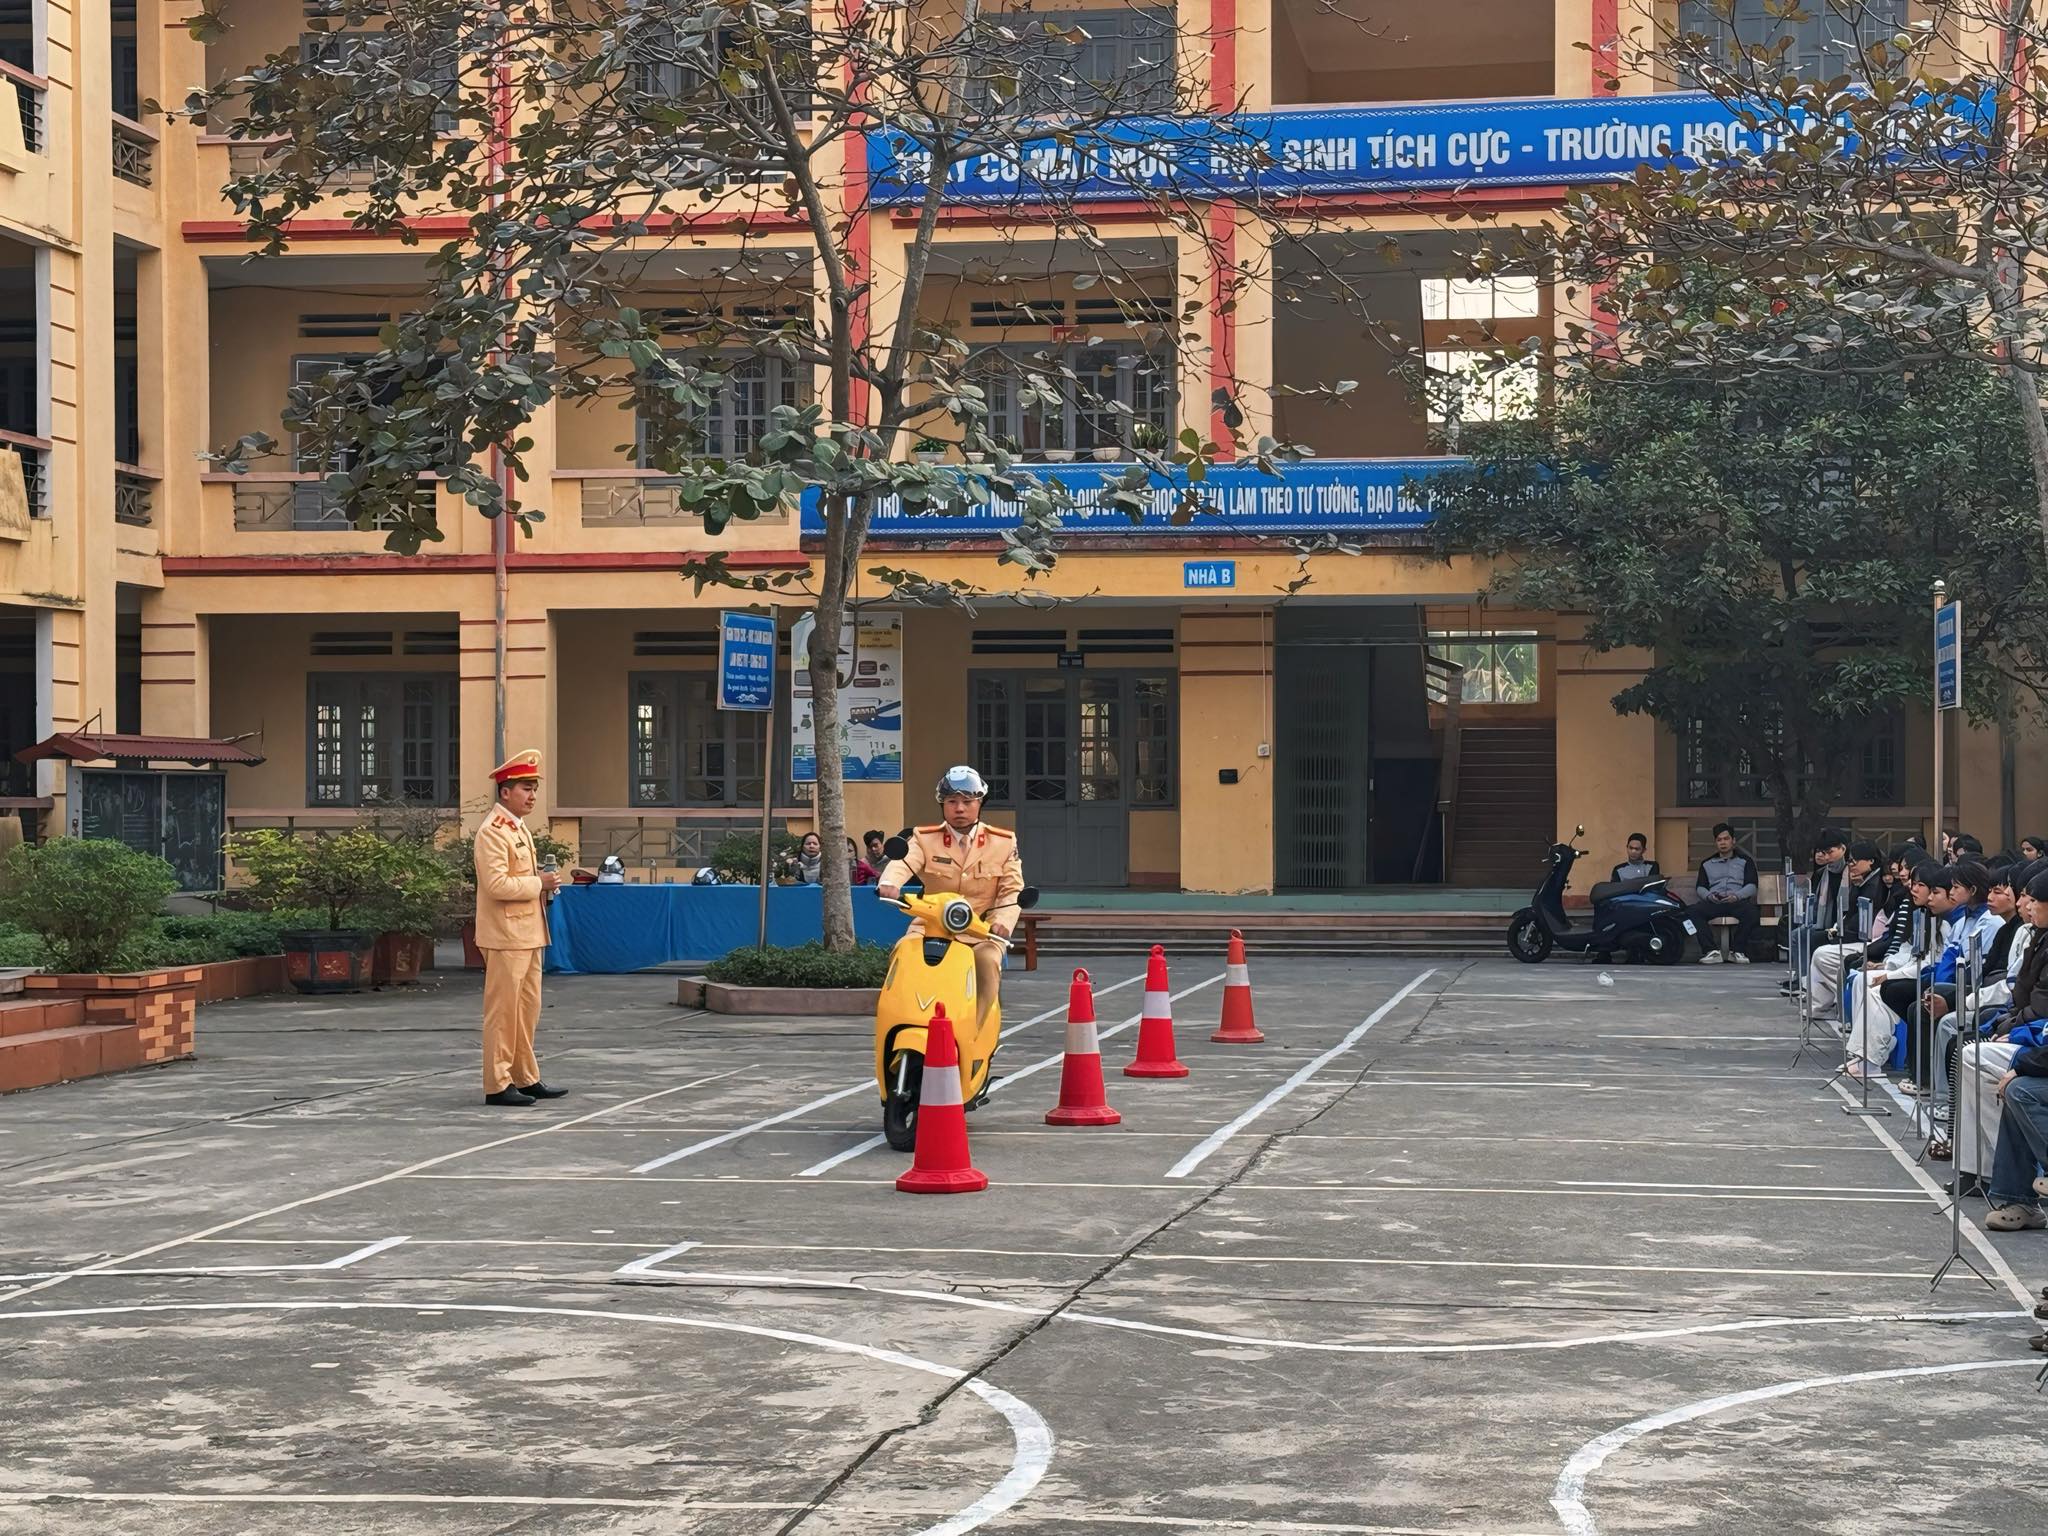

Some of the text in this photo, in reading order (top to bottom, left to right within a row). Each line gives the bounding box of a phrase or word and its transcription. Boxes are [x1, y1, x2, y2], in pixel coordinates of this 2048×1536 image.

[894, 150, 968, 185] THY
[979, 143, 1019, 183] CÔ
[1109, 141, 1179, 186] MỰC
[1282, 137, 1357, 173] SINH
[1366, 128, 1437, 170] TÍCH
[1447, 128, 1511, 173] CỰC
[1521, 145, 1534, 153] -
[1543, 117, 1672, 162] TRƯỜNG
[1683, 120, 1748, 163] HỌC
[1151, 487, 1177, 522] HỌC
[1208, 481, 1226, 515] VÀ
[1229, 481, 1257, 515] LÀM
[1260, 487, 1293, 515] THEO
[1296, 483, 1314, 515] TƯ
[1316, 476, 1363, 517] TƯỞNG,
[1367, 485, 1393, 520] ĐẠO
[1188, 564, 1231, 585] NHÀ B
